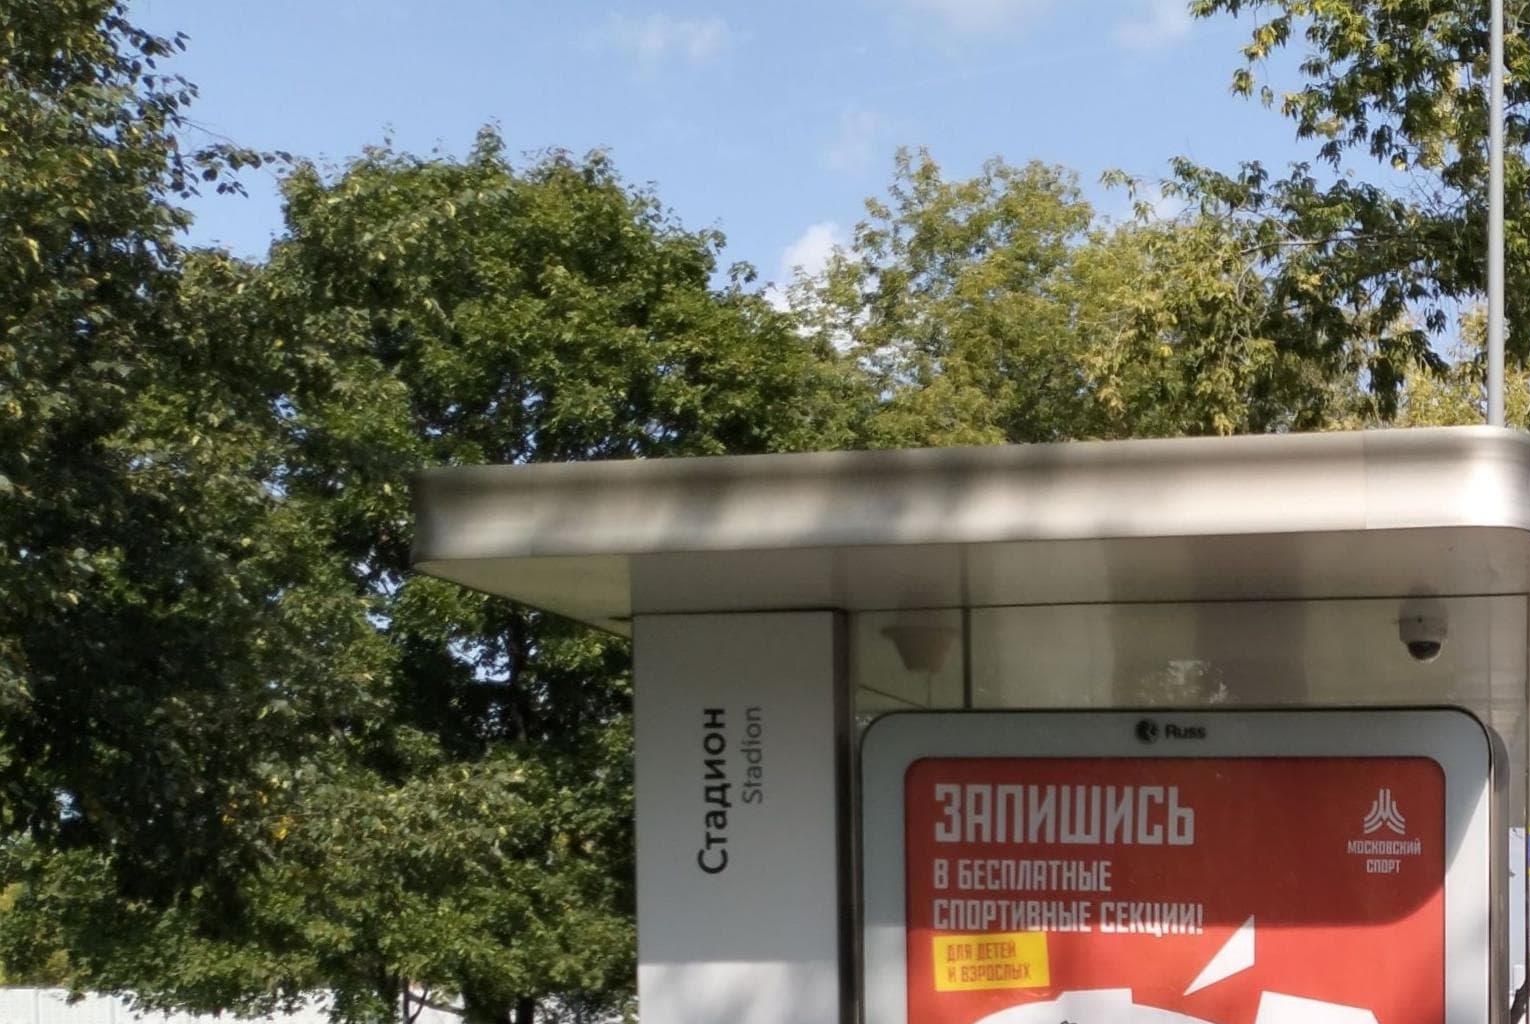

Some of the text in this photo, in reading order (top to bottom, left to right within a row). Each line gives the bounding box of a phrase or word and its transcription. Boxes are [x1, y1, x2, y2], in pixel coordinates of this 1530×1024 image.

[740, 707, 763, 804] Stadion
[698, 708, 731, 873] Стадион
[934, 783, 1195, 845] ЗАПИШИСЬ
[1347, 838, 1421, 855] МОСКОВСКИЙ
[934, 859, 1112, 892] В БЕСПЛАТНЫЕ
[1366, 859, 1401, 873] СПОРТ
[934, 899, 1203, 937] СПОРТИВНЫЕ СЕКЦИИ!
[947, 940, 1016, 962] ДЛЯ ДЕТЕЙ
[948, 963, 1032, 982] И ВЗРОСЛЫХ
